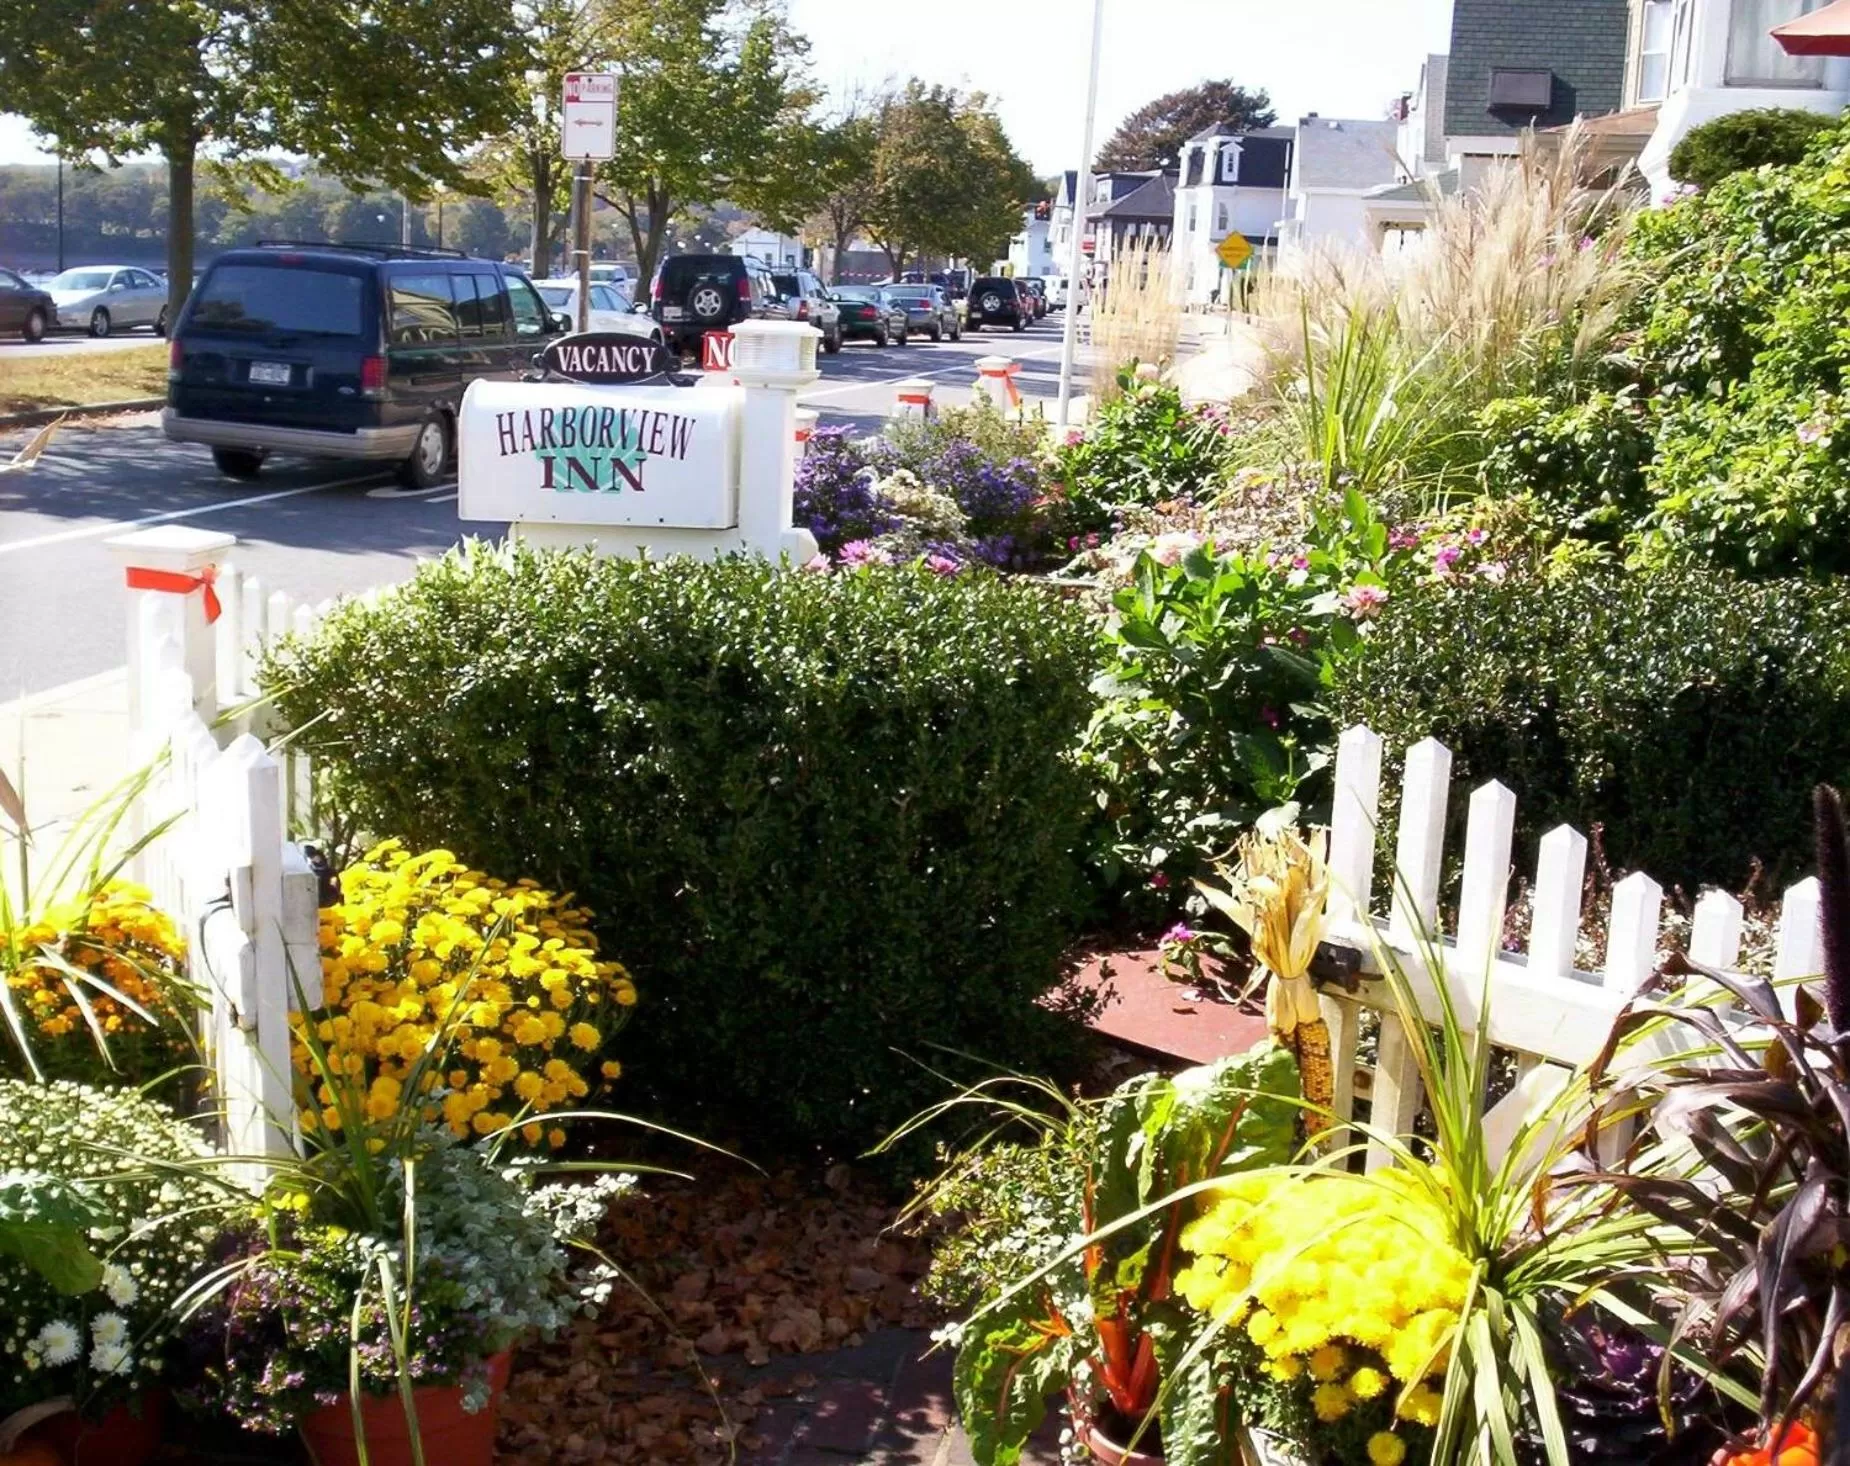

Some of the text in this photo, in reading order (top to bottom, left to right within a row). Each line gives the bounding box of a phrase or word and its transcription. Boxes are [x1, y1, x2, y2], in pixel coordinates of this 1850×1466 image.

[557, 345, 657, 373] VACANCY
[495, 405, 697, 461] HARBORVIEW
[540, 455, 646, 492] INN
